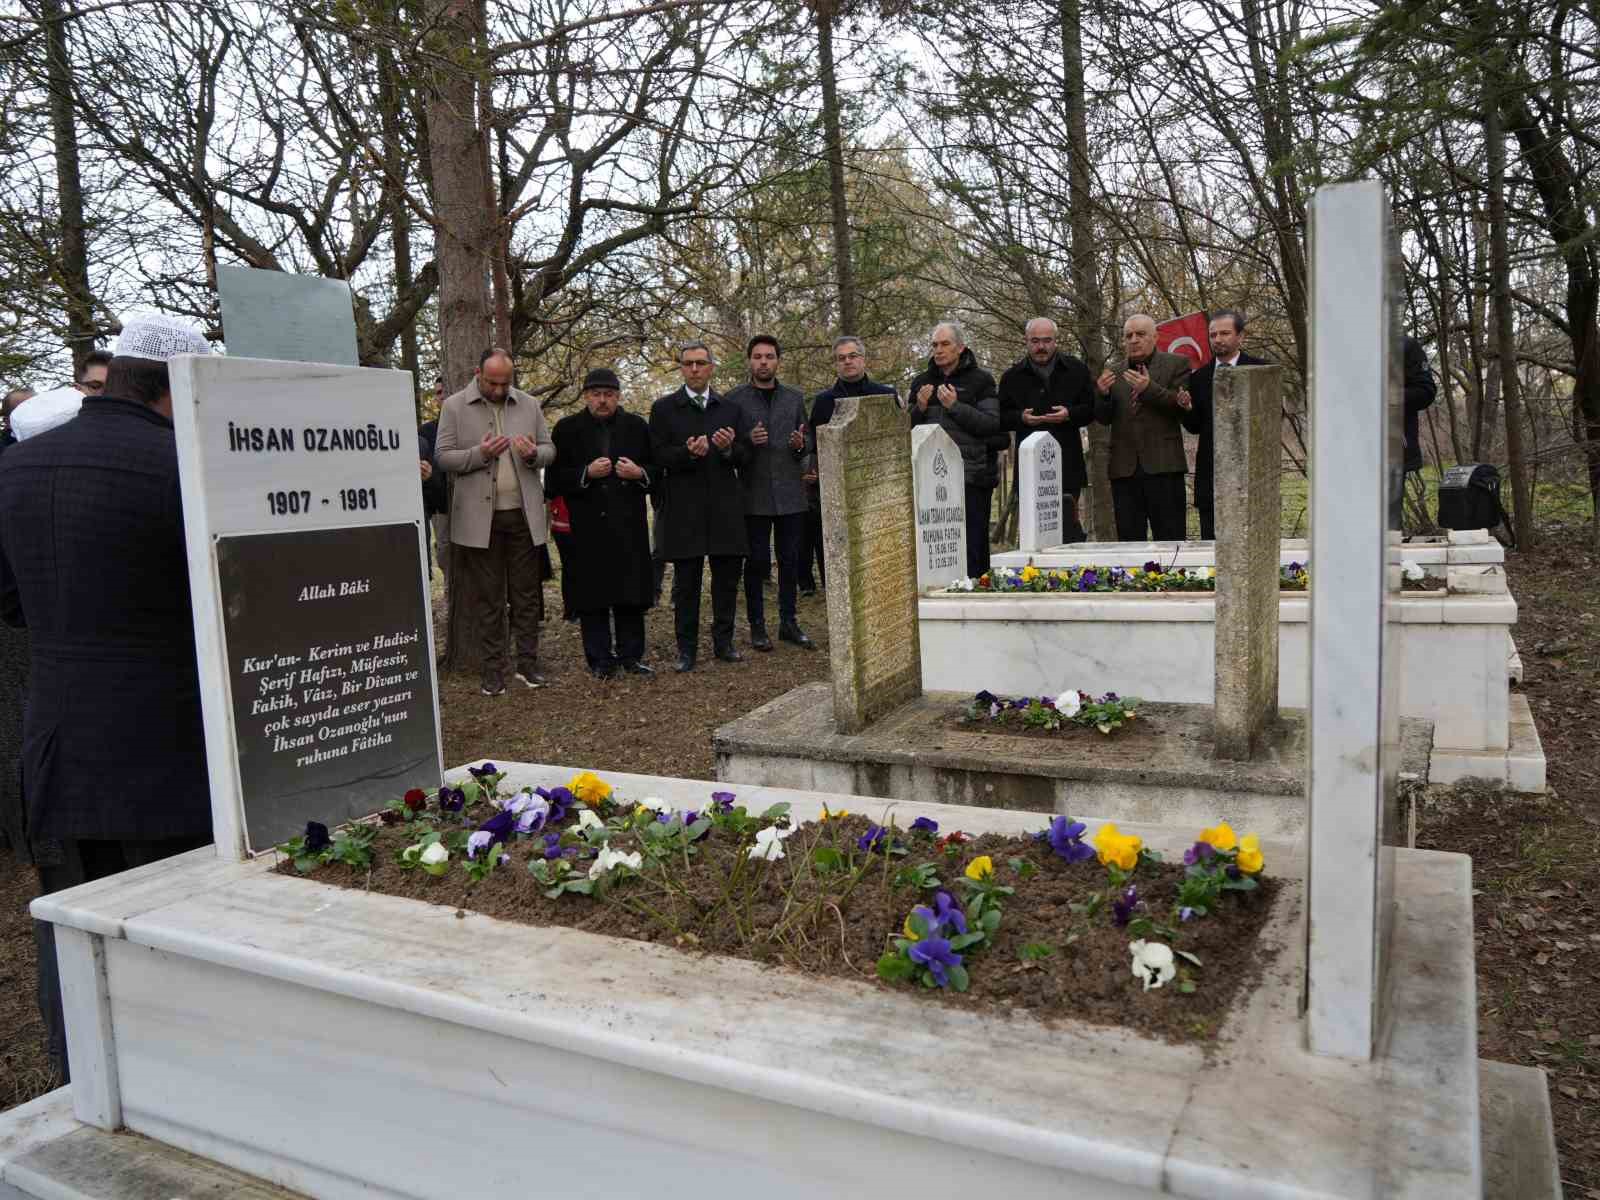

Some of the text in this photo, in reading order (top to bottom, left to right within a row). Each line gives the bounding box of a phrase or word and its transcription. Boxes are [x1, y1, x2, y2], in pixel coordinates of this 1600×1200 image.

[228, 421, 400, 451] İHSAN OZANOĞLU
[267, 491, 310, 515] 1907
[340, 488, 376, 510] 1981
[299, 579, 370, 601] Allah Bâki
[242, 629, 418, 673] Kur'an- Kerim ve Hadis-i
[251, 670, 418, 715] Fakih, Vâız, Bir Dîvan ve
[260, 651, 408, 694] Şerif Hafızı, Müfessir,
[264, 691, 411, 737] çok sayıda eser yazarı
[273, 710, 407, 752] İhsan Ozanoğlu'nun
[296, 733, 392, 767] ruhuna Fâtiha
